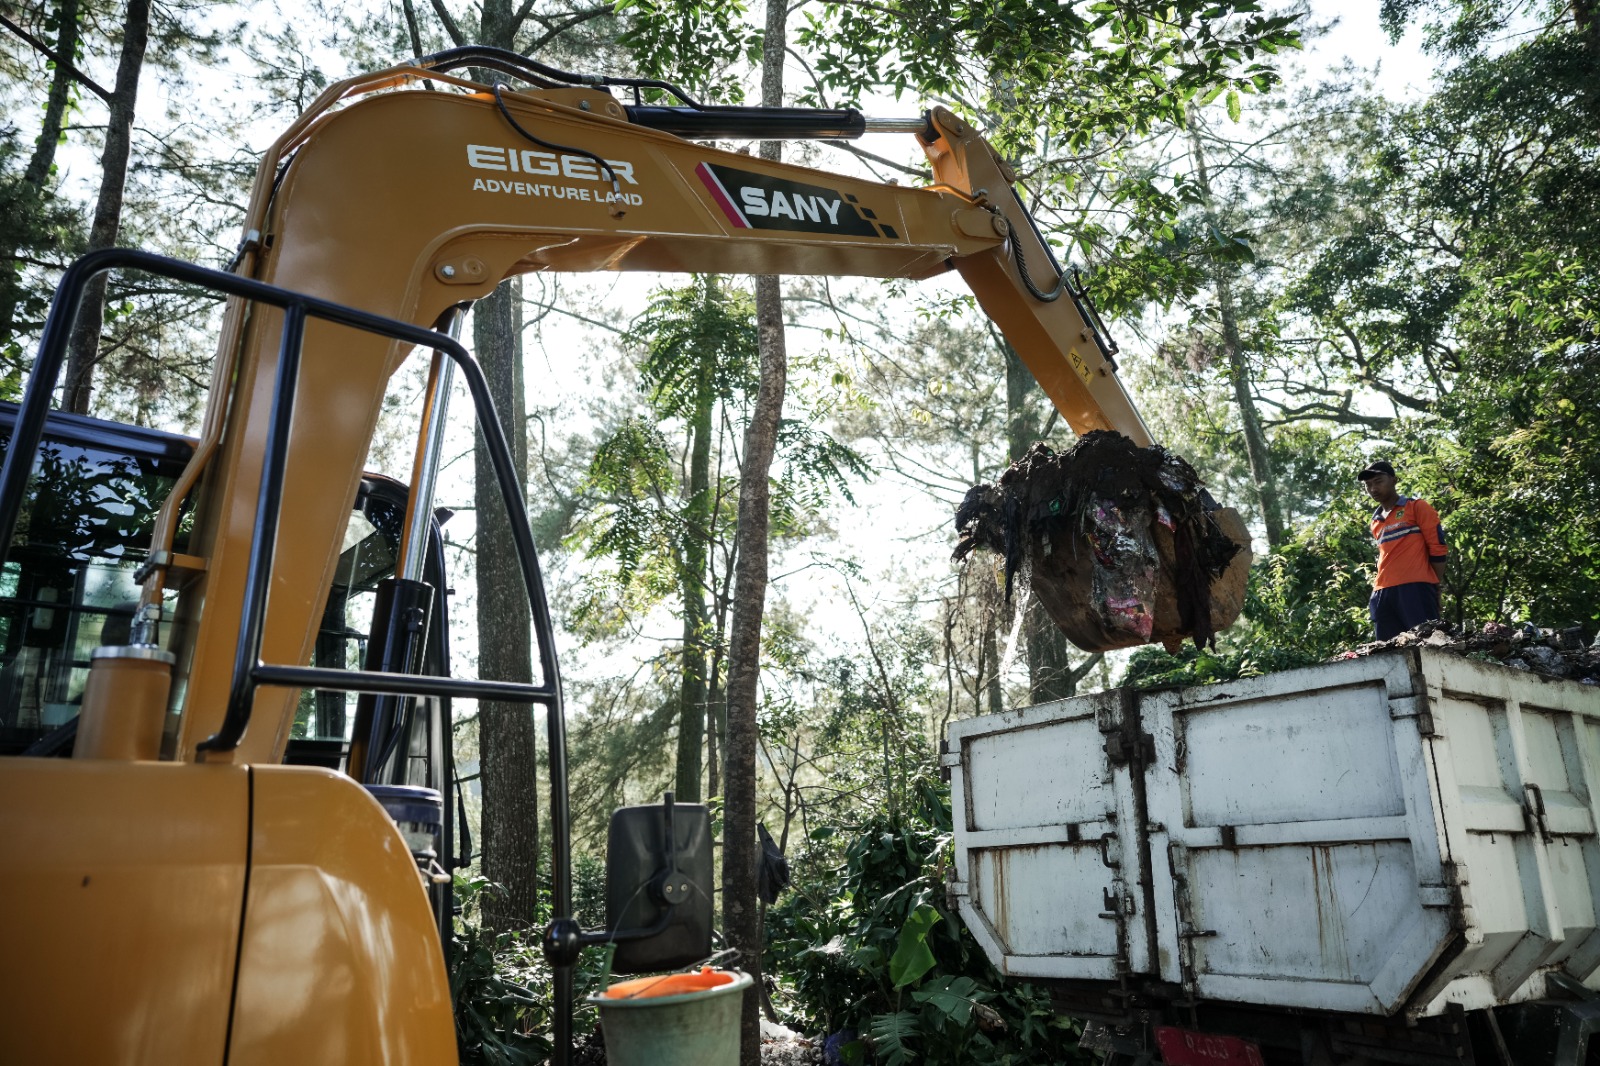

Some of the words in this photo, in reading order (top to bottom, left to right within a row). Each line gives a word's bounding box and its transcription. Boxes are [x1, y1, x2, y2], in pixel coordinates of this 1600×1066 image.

[466, 144, 639, 185] EIGER
[472, 178, 591, 202] ADVENTURE
[593, 189, 643, 206] LAND
[740, 186, 841, 225] SANY
